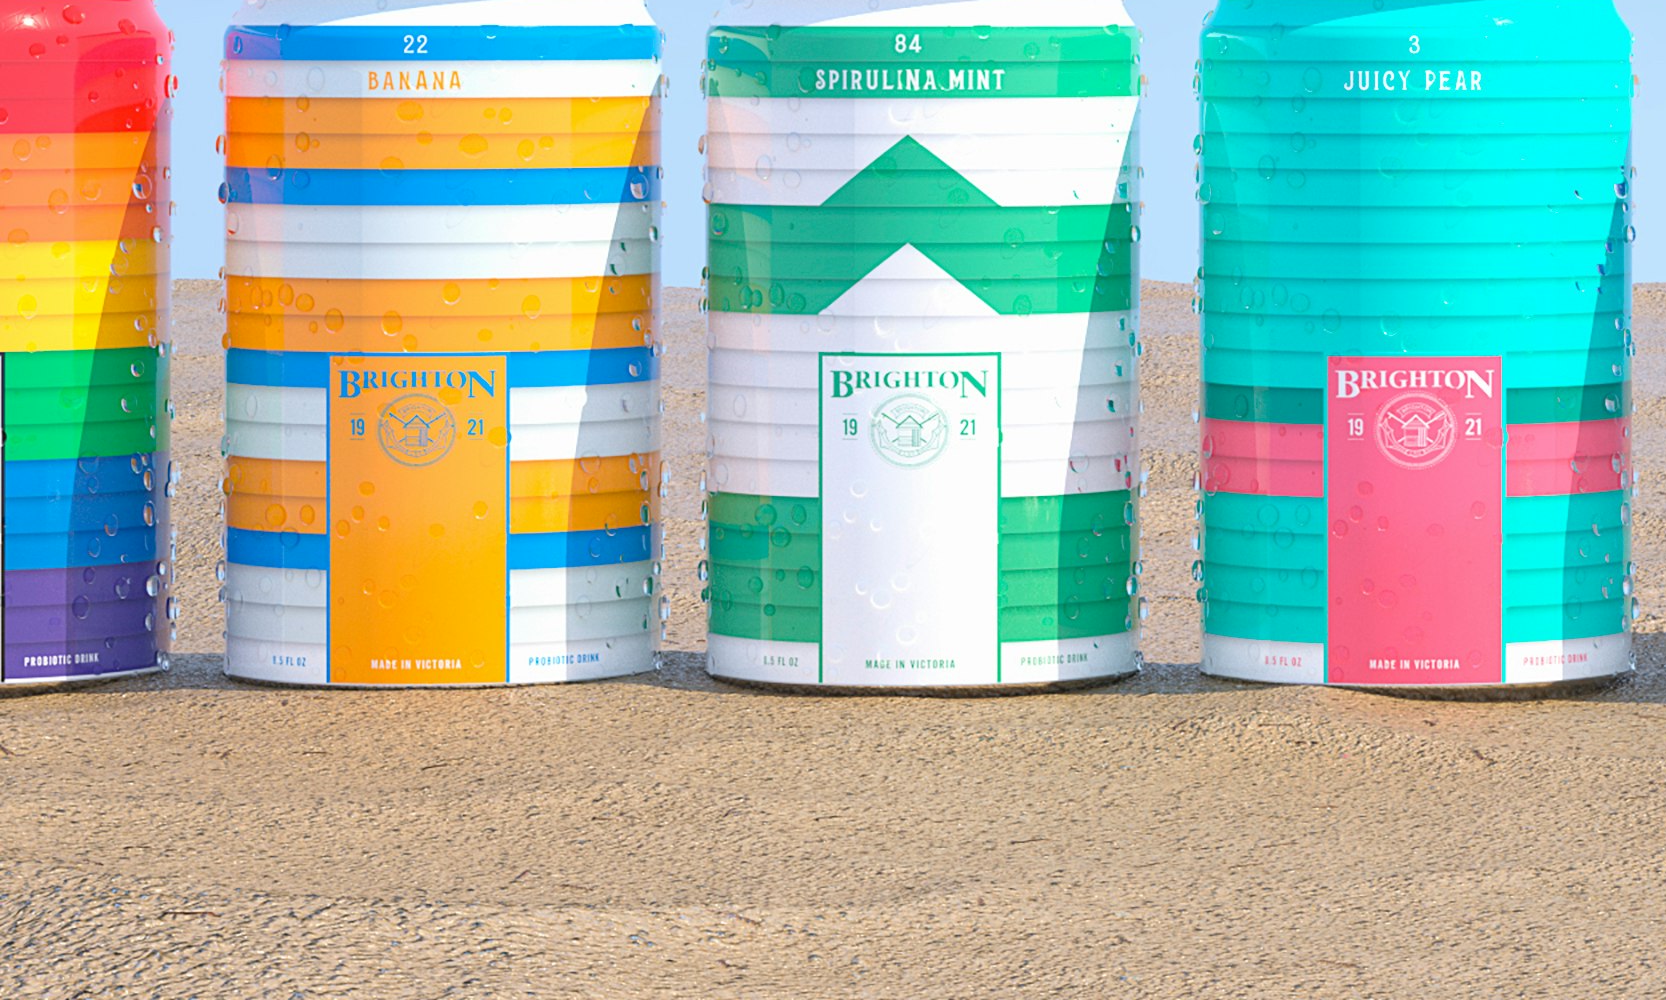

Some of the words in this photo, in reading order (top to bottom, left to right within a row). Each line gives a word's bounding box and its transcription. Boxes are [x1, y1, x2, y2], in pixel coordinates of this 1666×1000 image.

[403, 34, 428, 54] 22
[894, 33, 922, 53] 84
[1408, 34, 1421, 54] 3
[368, 69, 462, 91] BANANA
[815, 68, 938, 91] SPIRULINA
[948, 68, 1006, 90] MINT
[1343, 69, 1411, 91] JUICY
[1424, 69, 1482, 91] PEAR
[338, 369, 496, 399] BRIGHTON
[830, 369, 989, 399] BRIGHTON
[1335, 369, 1495, 399] BRIGHTON
[350, 418, 365, 436] 19
[467, 418, 484, 436] 21
[842, 418, 858, 436] 19
[960, 418, 976, 436] 21
[1347, 418, 1364, 436] 19
[1465, 418, 1482, 436] 21
[24, 654, 72, 667] PROBIOTIC
[75, 652, 99, 665] DRINK
[286, 657, 294, 666] FL
[297, 657, 306, 667] OZ
[371, 659, 398, 670] MADE
[401, 659, 411, 670] IN
[416, 659, 462, 670] VICTORIA
[528, 655, 574, 666] PROBIOTIC
[577, 653, 600, 664] DRINK
[777, 657, 786, 666] FL
[788, 657, 799, 667] OZ
[865, 659, 891, 670] MADE
[895, 659, 905, 670] IN
[910, 659, 956, 670] VICTORIA
[1020, 655, 1064, 666] PROBIOTIC
[1067, 653, 1088, 664] DRINK
[1279, 657, 1288, 666] FL
[1291, 657, 1302, 667] OZ
[1369, 659, 1397, 670] MADE
[1400, 659, 1411, 670] IN
[1414, 659, 1460, 670] VICTORIA
[1523, 654, 1565, 666] PROBIOTIC
[1567, 653, 1588, 664] DRINK
